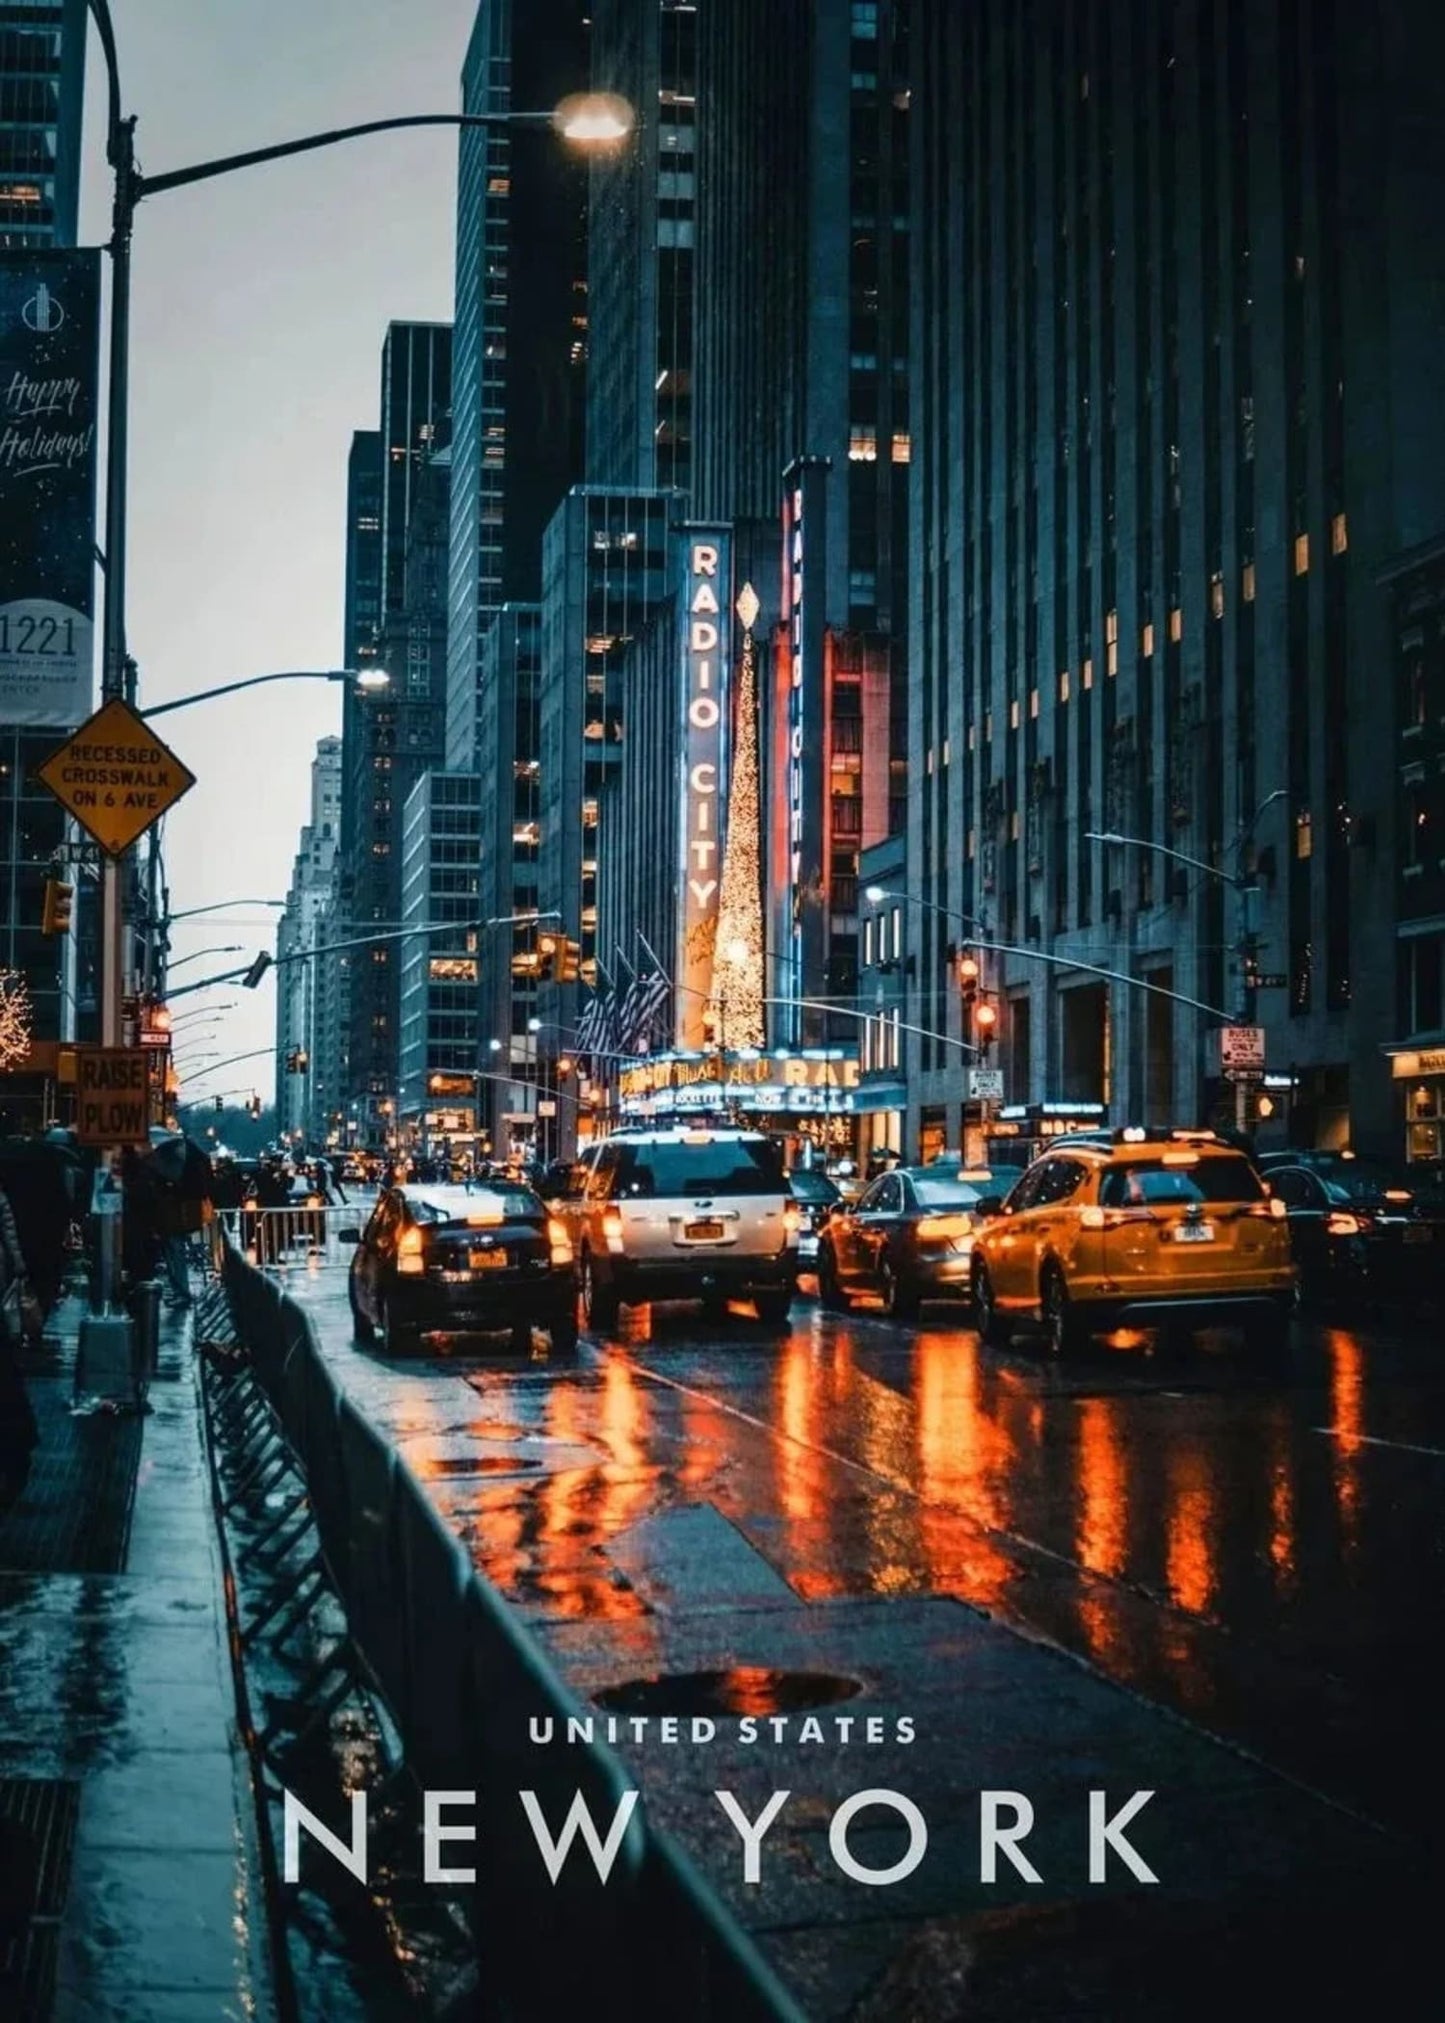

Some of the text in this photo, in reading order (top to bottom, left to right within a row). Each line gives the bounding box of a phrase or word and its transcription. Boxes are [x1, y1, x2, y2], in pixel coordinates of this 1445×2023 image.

[4, 371, 81, 417] Happy
[0, 614, 76, 656] 1221
[689, 545, 720, 729] RADIO
[71, 744, 161, 764] RECESSED
[62, 767, 168, 787] CROSSWALK
[73, 790, 158, 808] ON 6 AVE
[689, 763, 718, 909] CITY
[83, 1059, 142, 1090] RAISE
[85, 1102, 142, 1133] PLOW
